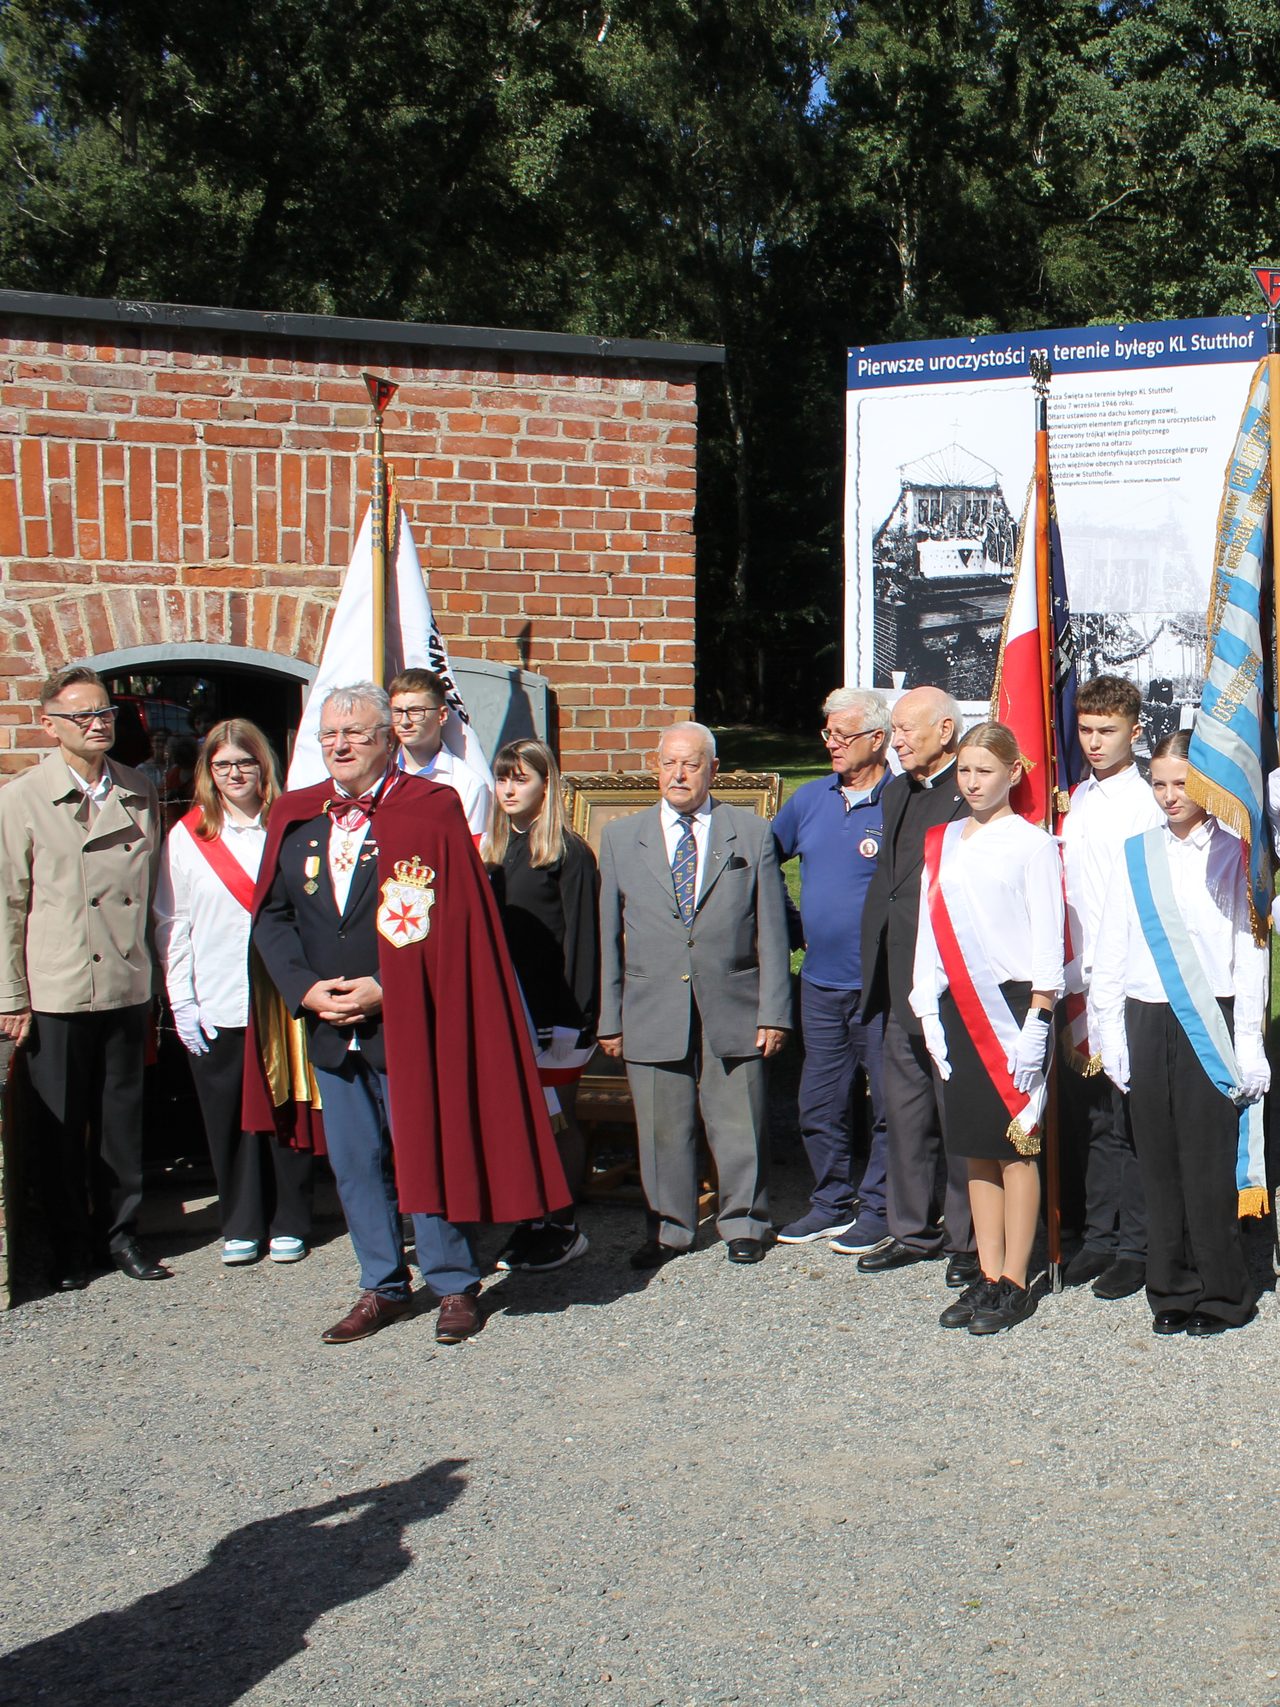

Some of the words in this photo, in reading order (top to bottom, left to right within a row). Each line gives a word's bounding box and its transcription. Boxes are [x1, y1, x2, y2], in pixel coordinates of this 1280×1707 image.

[858, 357, 924, 377] Pierwsze
[929, 346, 1025, 372] uroczystości
[1054, 341, 1110, 361] terenie
[1115, 338, 1164, 360] byłego
[1170, 336, 1187, 352] KL
[1191, 331, 1254, 351] Stutthof
[1124, 418, 1156, 428] graficznym
[1167, 415, 1216, 424] uroczystościach
[1132, 428, 1169, 436] politycznego
[1148, 446, 1188, 455] poszczególne
[1134, 458, 1182, 466] uroczystościach
